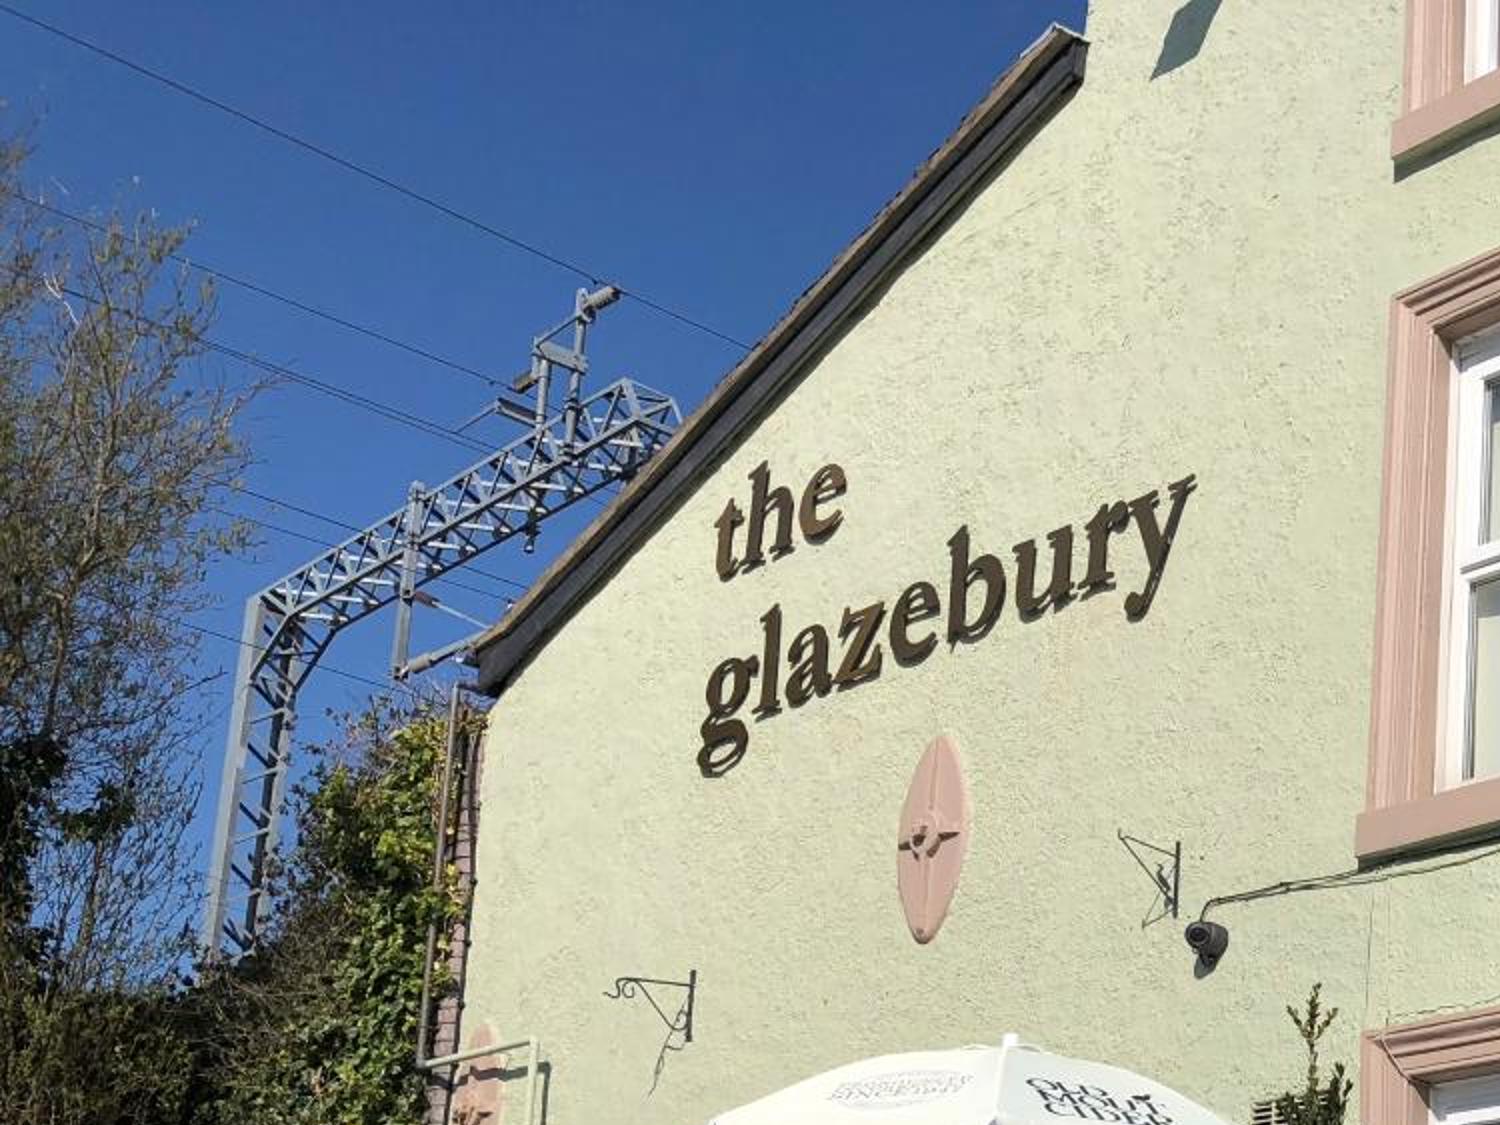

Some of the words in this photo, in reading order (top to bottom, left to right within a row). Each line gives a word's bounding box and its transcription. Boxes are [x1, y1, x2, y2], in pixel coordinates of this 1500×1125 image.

[714, 461, 848, 582] the
[697, 474, 1197, 778] glazebury
[1026, 1078, 1108, 1097] OLD
